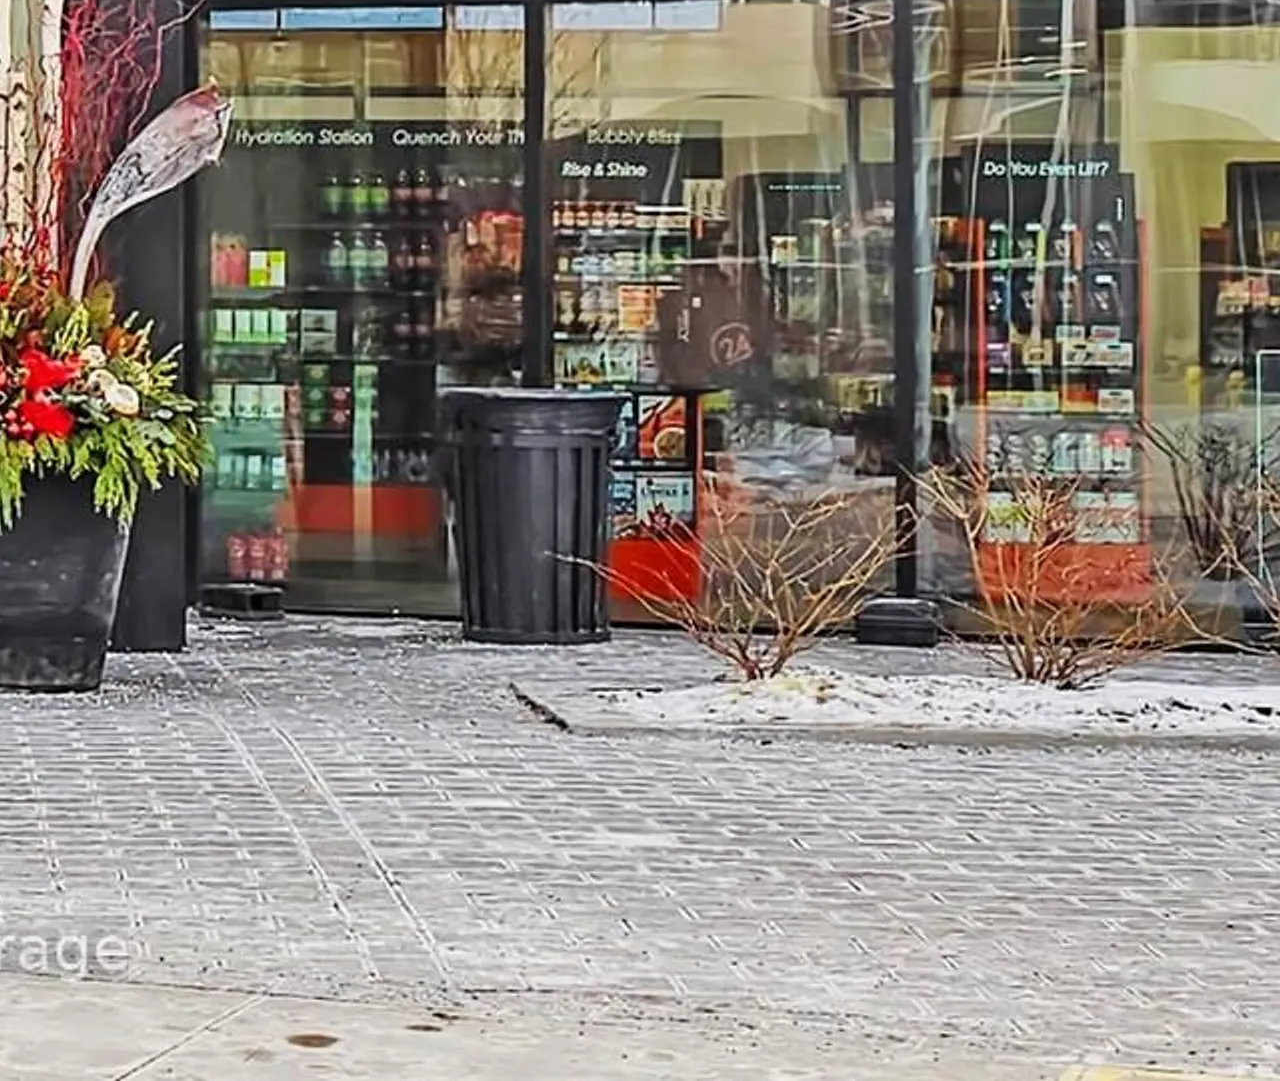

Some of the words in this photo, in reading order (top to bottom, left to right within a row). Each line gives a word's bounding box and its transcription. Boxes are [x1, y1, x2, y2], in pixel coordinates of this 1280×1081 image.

[235, 129, 314, 148] Hydration
[318, 128, 374, 146] Station
[392, 128, 461, 147] Quench
[464, 128, 502, 146] Your
[561, 161, 592, 177] Rise
[606, 161, 648, 177] Shine
[983, 160, 1006, 176] Do
[1008, 160, 1037, 176] You
